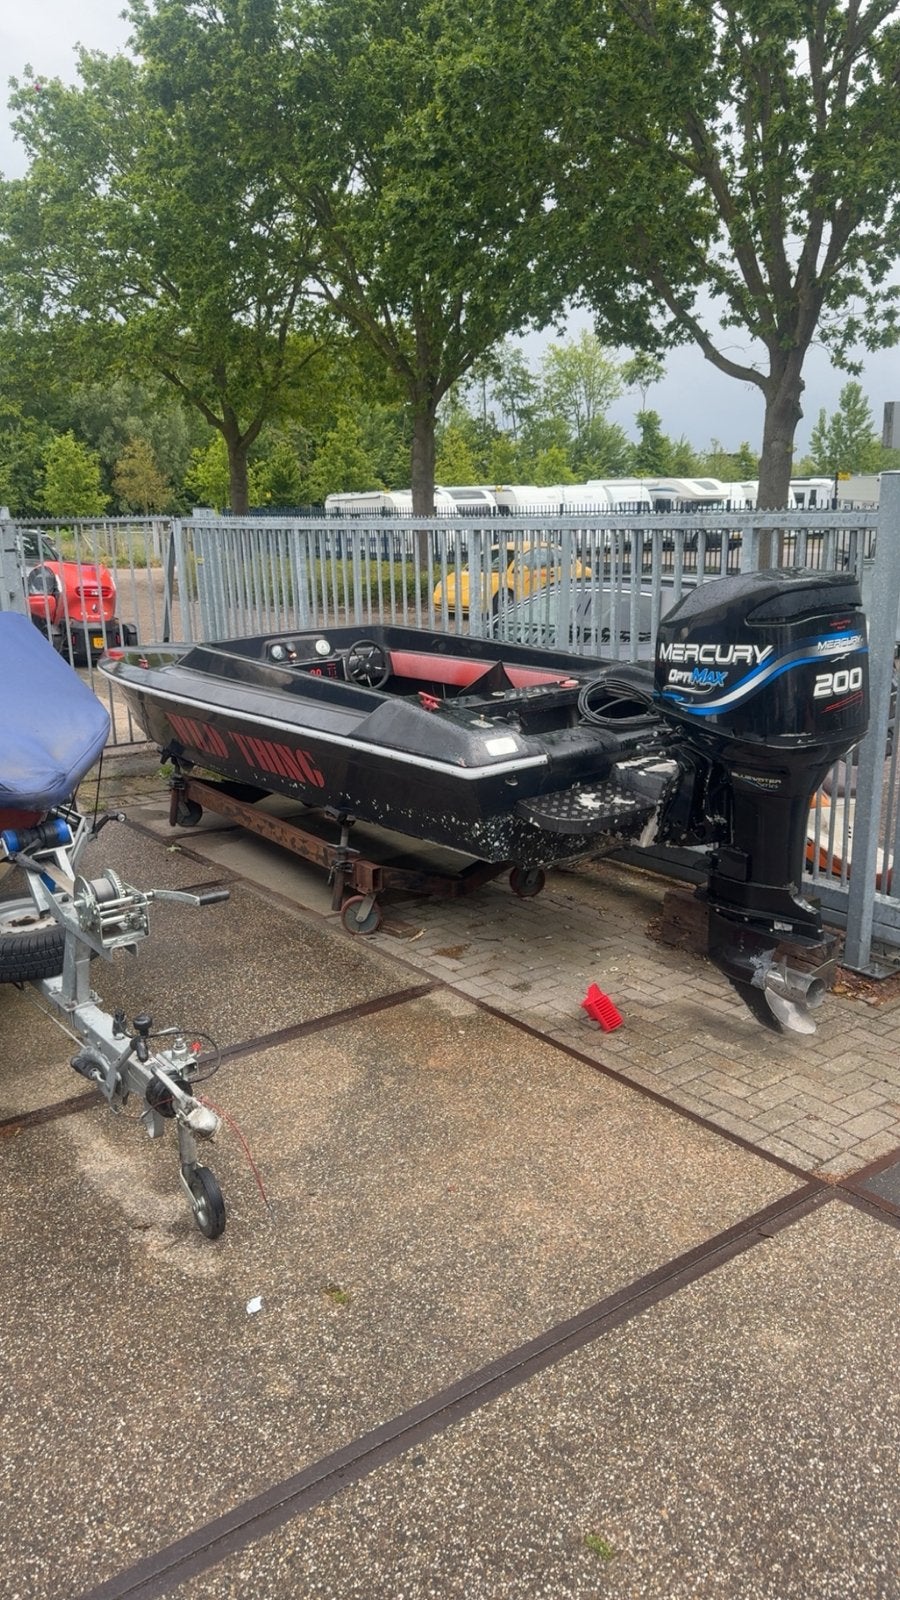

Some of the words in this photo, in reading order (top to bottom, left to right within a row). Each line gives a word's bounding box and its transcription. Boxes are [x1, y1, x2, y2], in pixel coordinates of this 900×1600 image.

[659, 642, 774, 666] MERCURY
[817, 635, 862, 651] MERCURY
[813, 667, 863, 699] 200
[228, 730, 325, 789] THING
